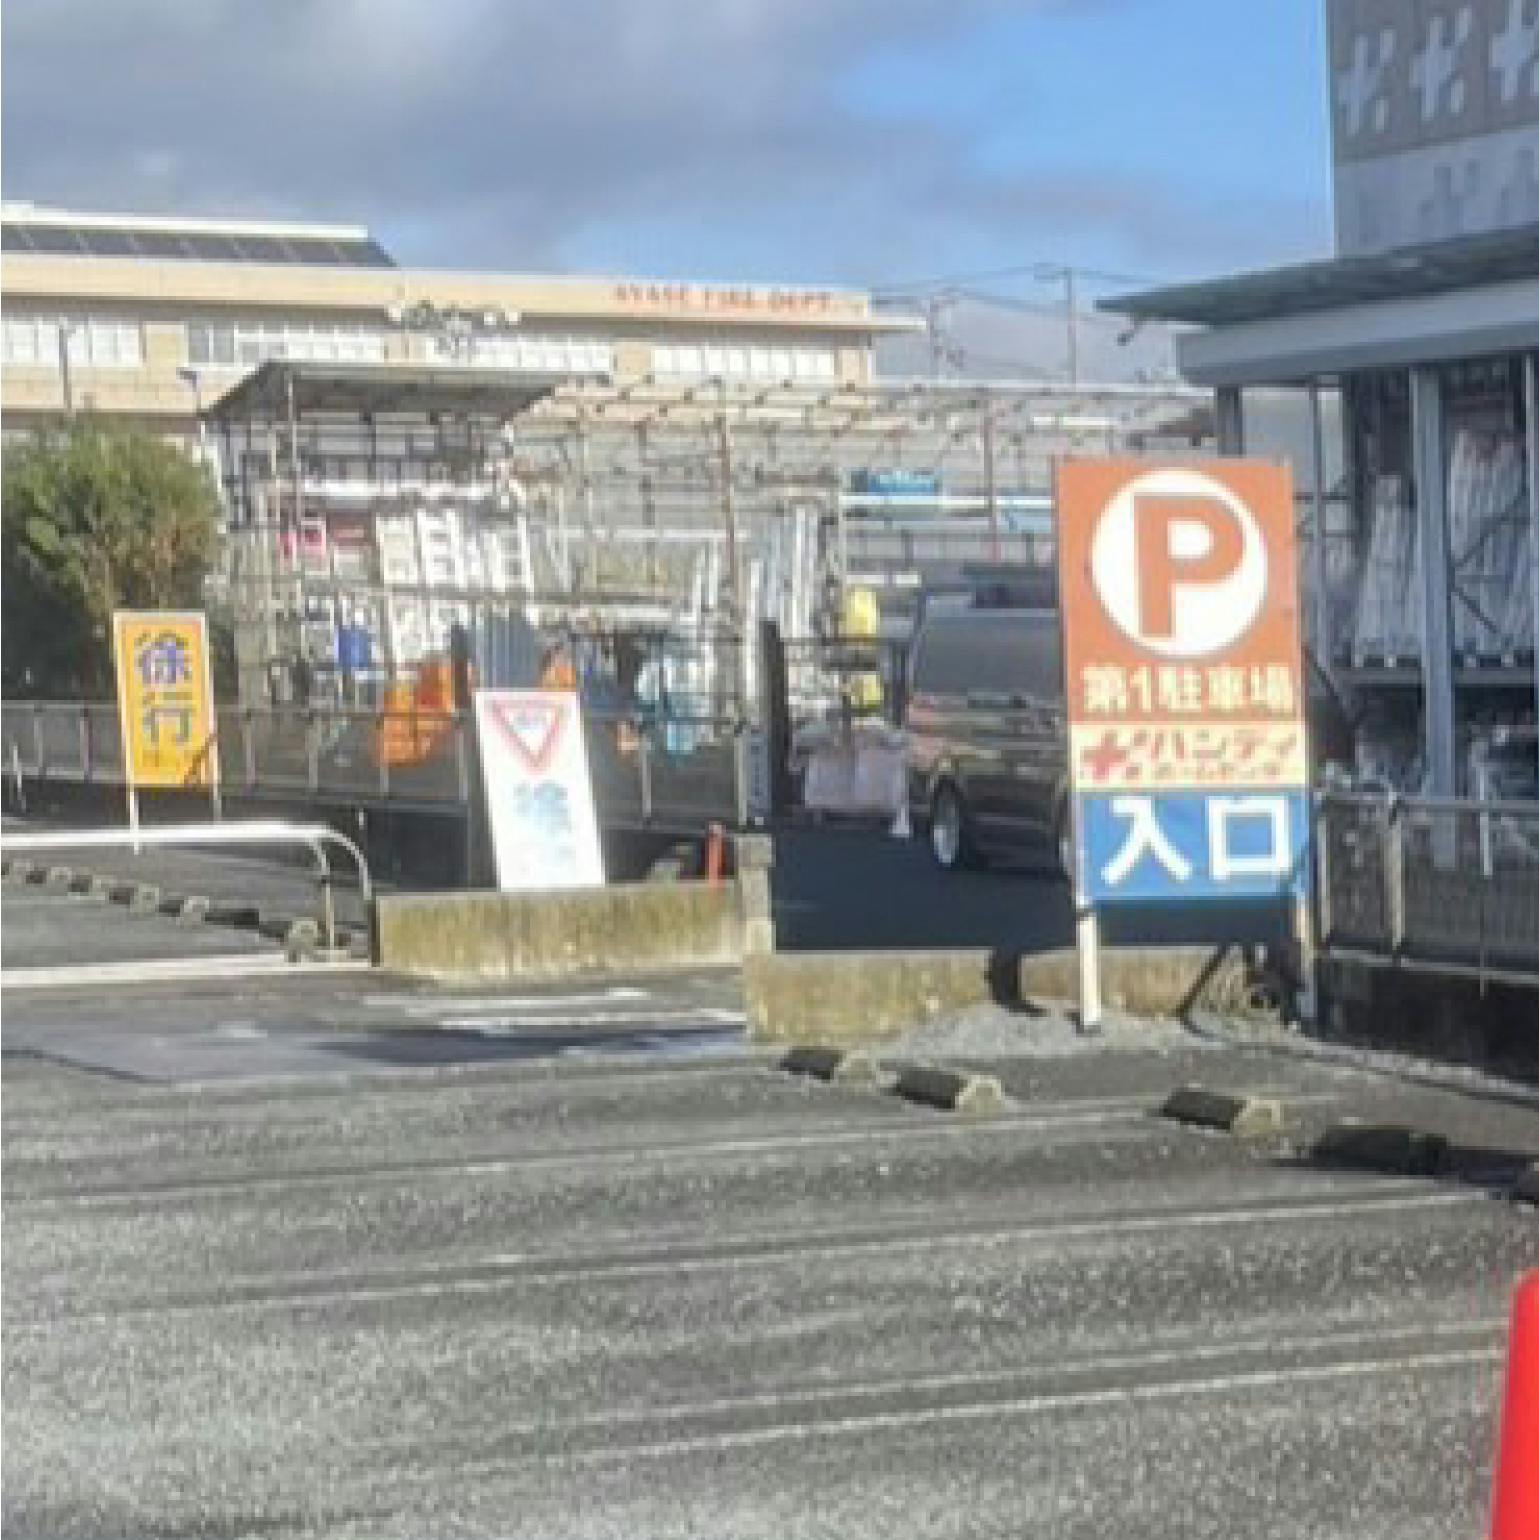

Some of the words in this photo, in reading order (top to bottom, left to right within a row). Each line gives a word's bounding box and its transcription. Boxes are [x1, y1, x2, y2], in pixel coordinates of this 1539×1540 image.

[1133, 495, 1247, 638] P
[1080, 664, 1295, 714] 第1駐車場
[1101, 796, 1292, 885] 入口
